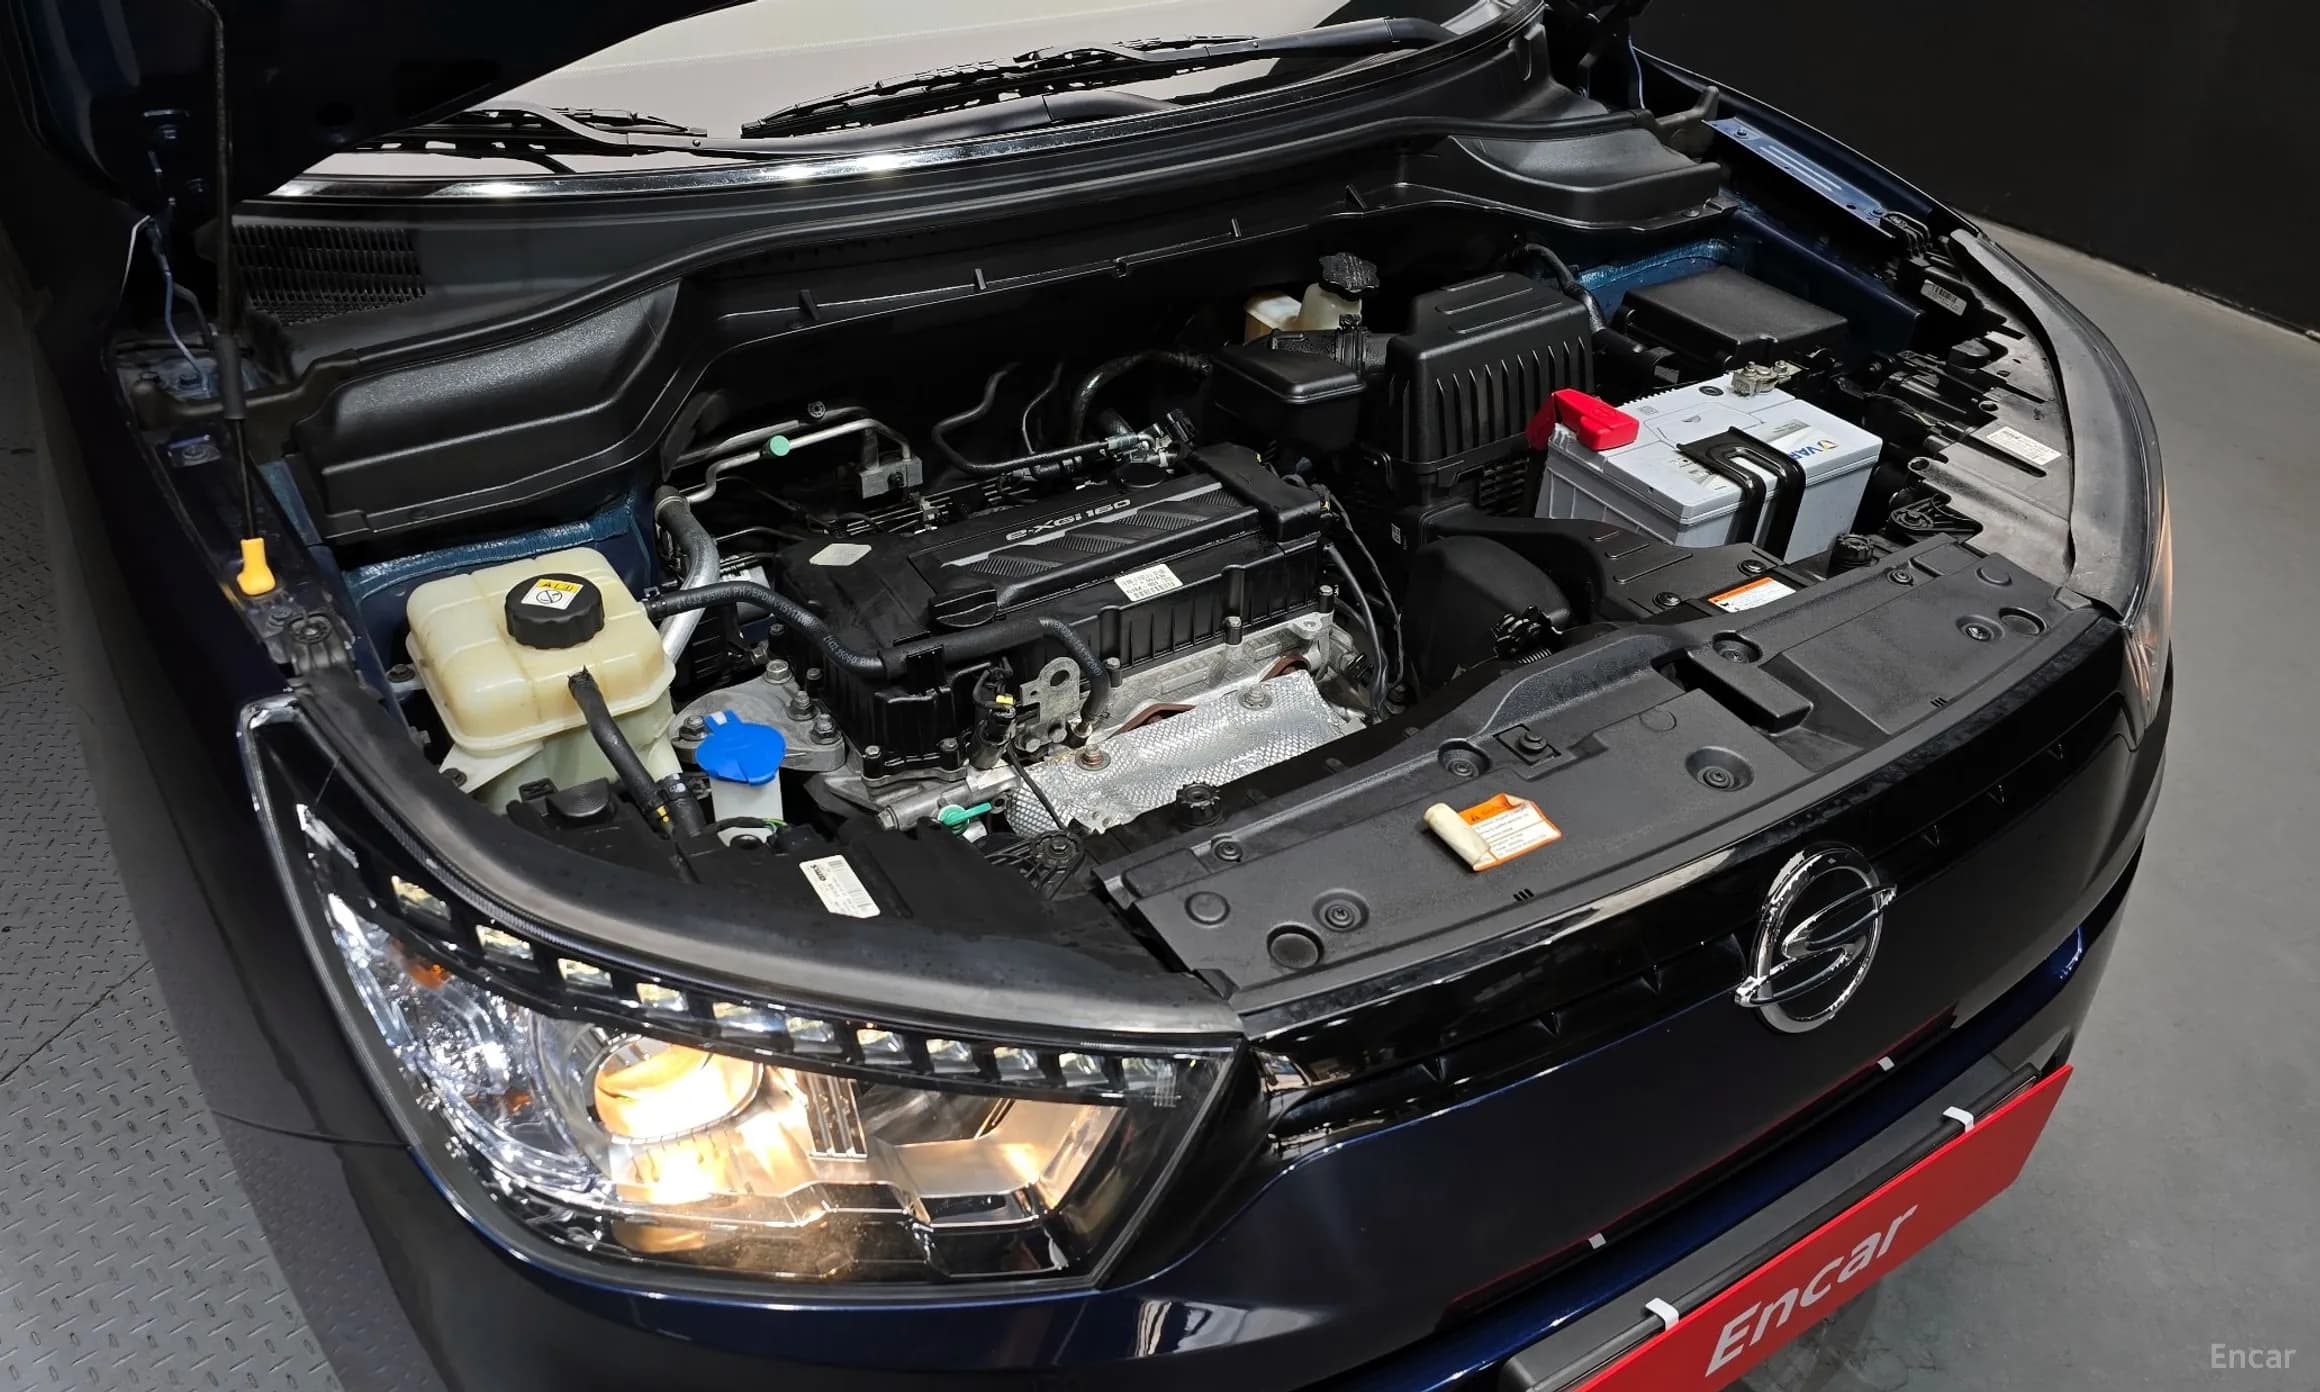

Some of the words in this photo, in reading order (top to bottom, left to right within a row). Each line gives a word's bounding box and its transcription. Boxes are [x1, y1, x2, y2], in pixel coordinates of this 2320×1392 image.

[1788, 446, 1824, 460] VAR
[1086, 499, 1131, 518] 160
[1705, 1205, 1918, 1377] Encar
